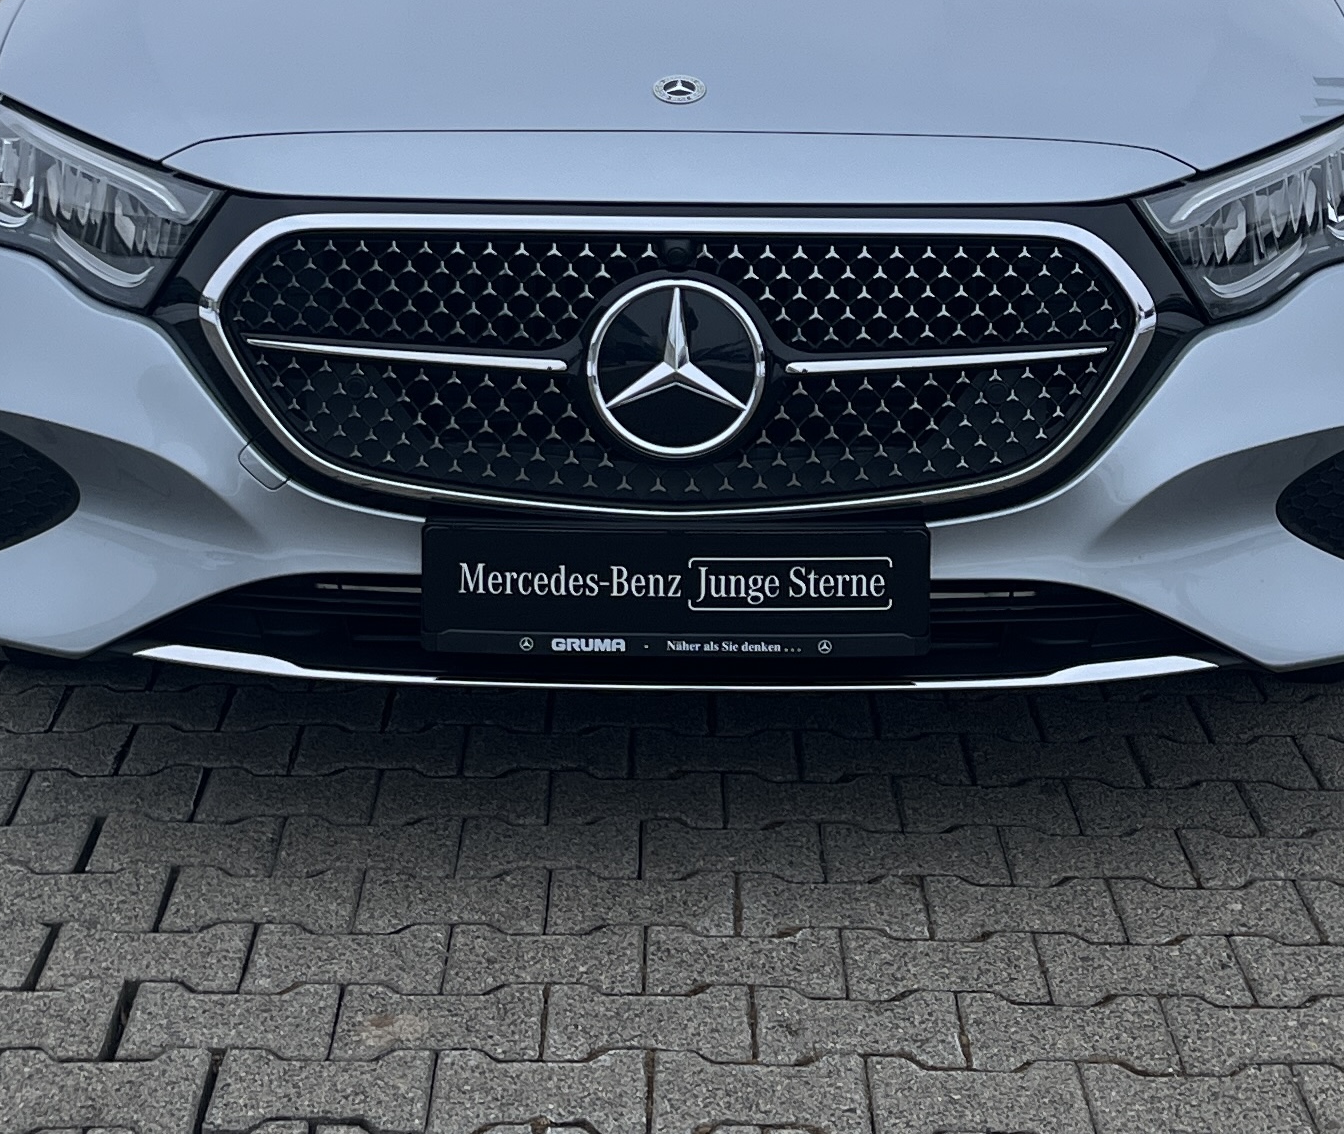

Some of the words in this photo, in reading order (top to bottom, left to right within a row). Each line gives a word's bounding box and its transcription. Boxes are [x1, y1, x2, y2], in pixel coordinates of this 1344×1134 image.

[458, 562, 682, 597] Mercedes-Benz
[696, 566, 780, 605] Junge
[788, 566, 886, 598] Sterne
[551, 638, 626, 652] GRUMA
[666, 640, 701, 652] Näher
[704, 641, 719, 652] als
[721, 641, 739, 652] Sie
[741, 641, 781, 653] denken
